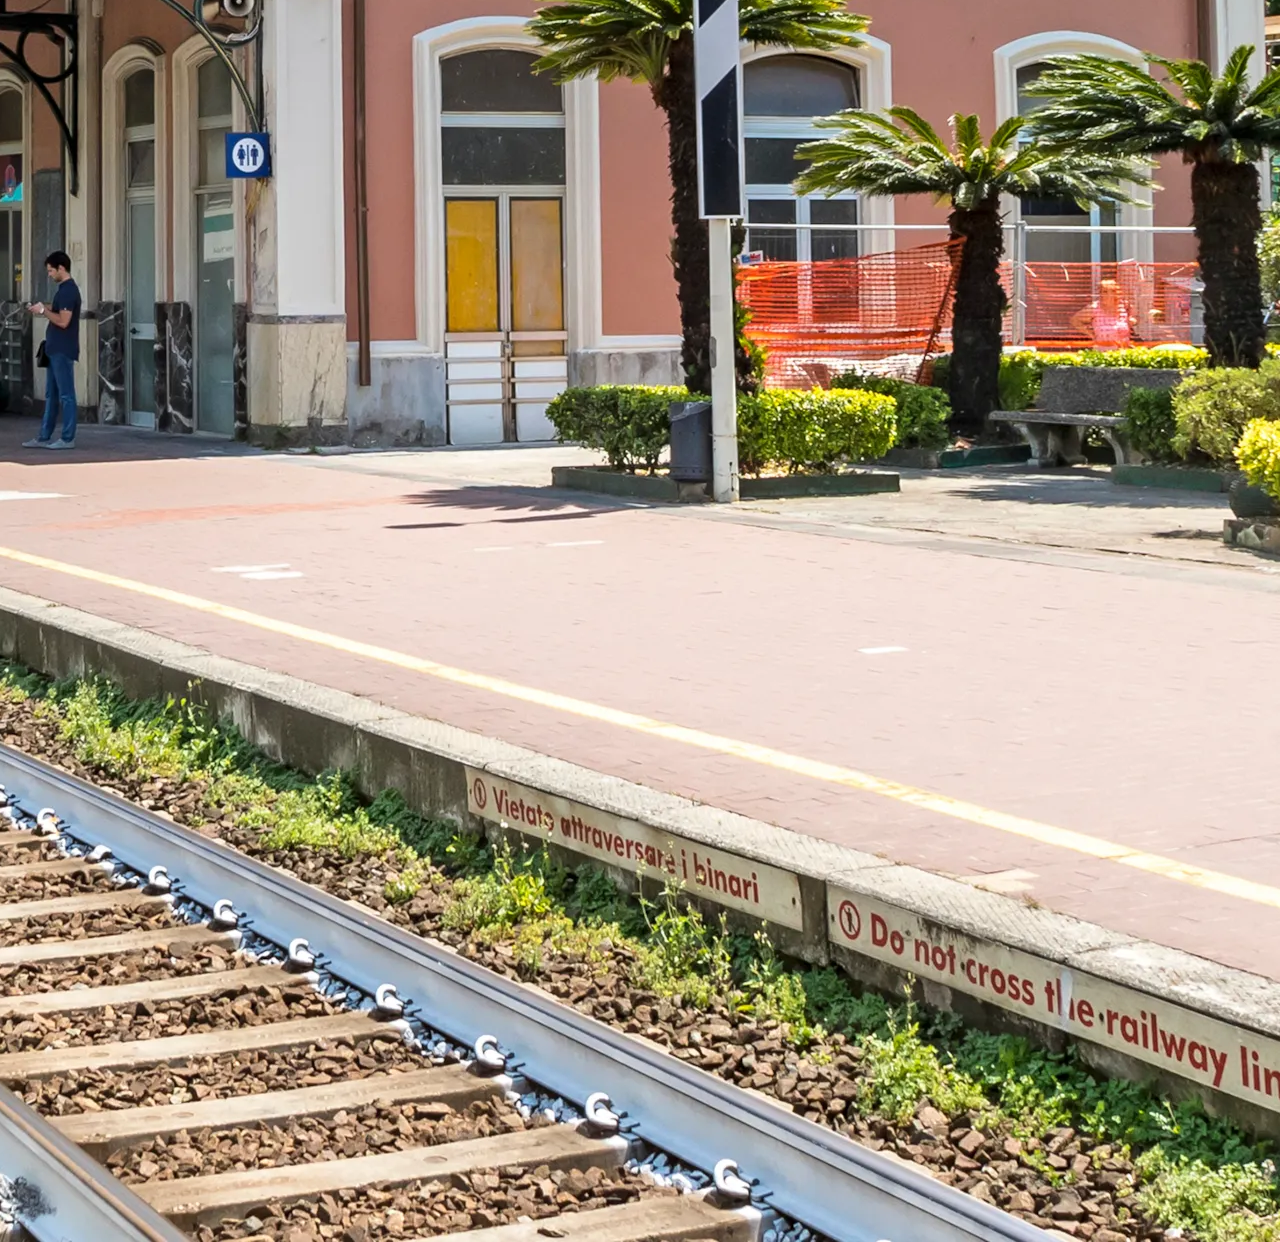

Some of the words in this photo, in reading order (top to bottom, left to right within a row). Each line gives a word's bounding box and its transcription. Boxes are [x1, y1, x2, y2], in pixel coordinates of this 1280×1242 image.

[492, 785, 555, 832] Vietato
[560, 814, 676, 875] attraversare
[693, 852, 759, 904] binari
[870, 912, 905, 955] Do
[914, 938, 957, 975] not
[966, 958, 1035, 1006] cross
[1106, 1009, 1227, 1088] railway
